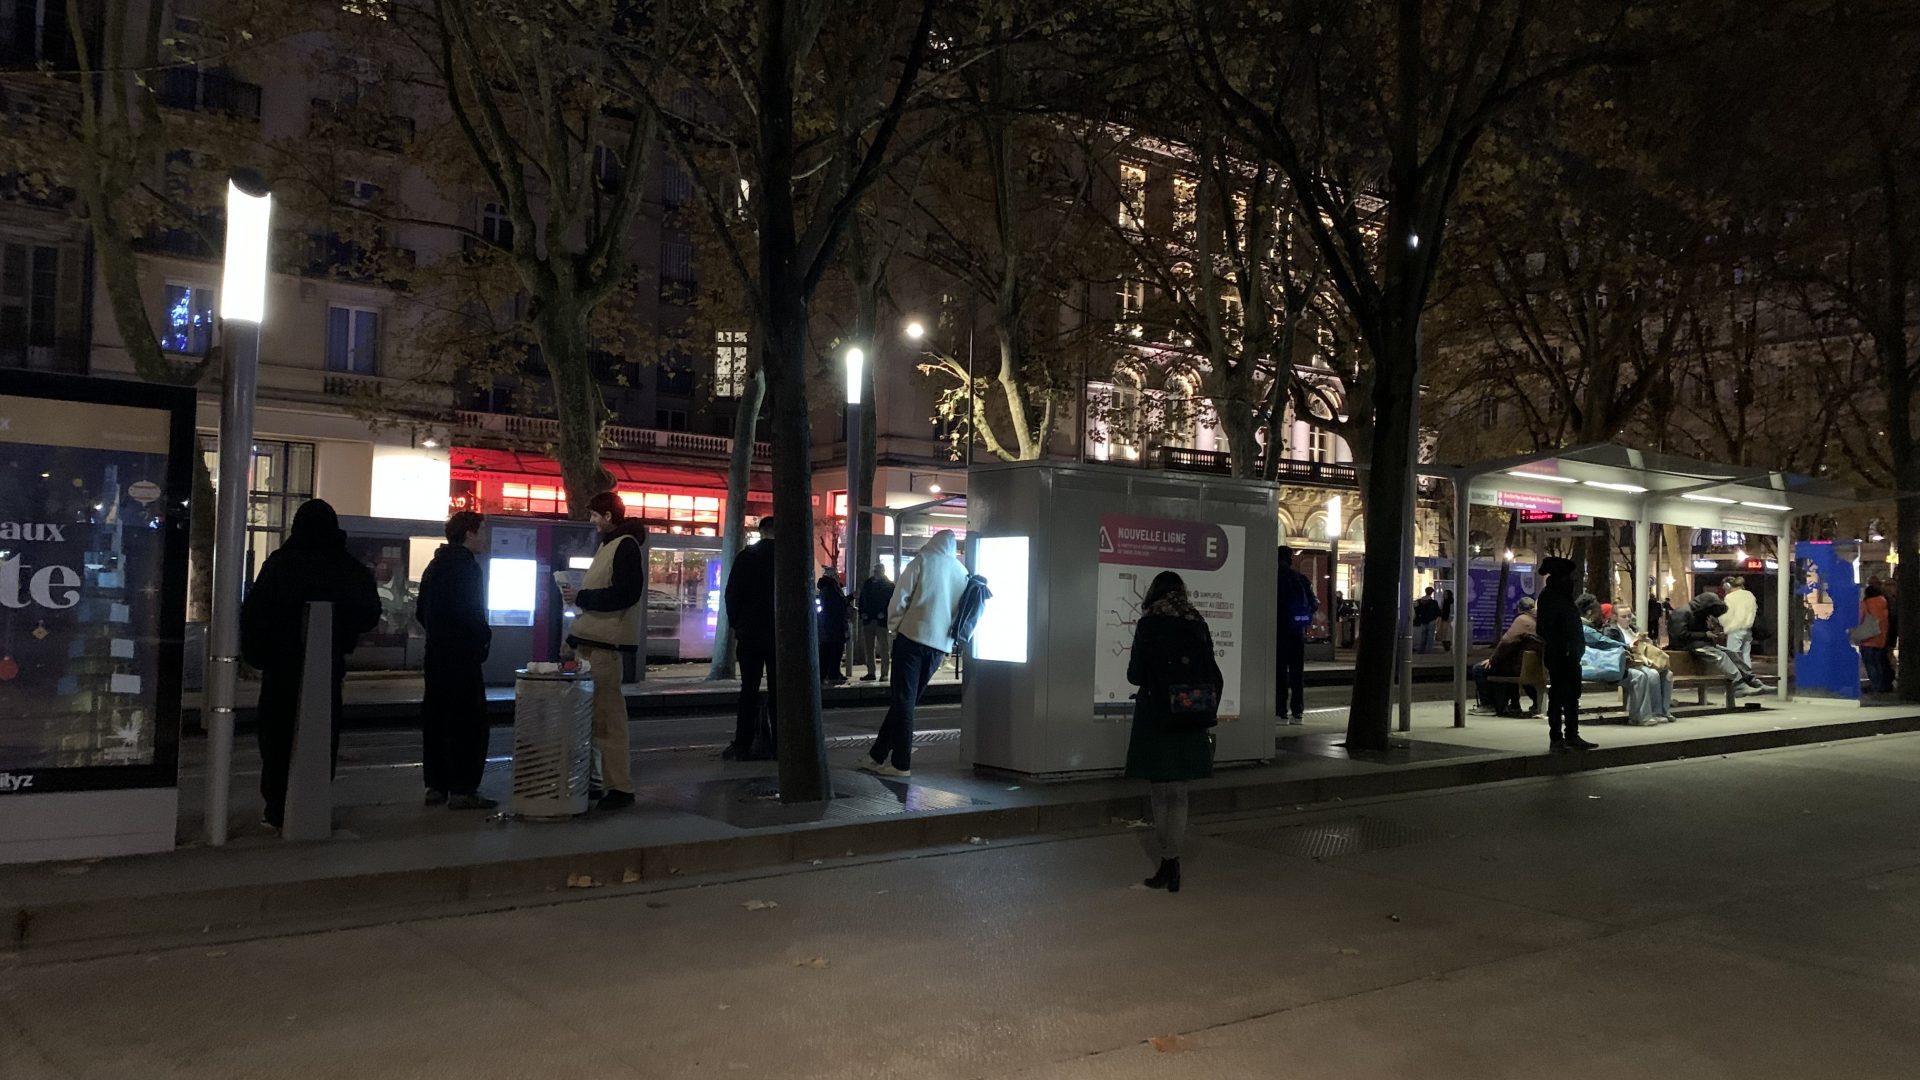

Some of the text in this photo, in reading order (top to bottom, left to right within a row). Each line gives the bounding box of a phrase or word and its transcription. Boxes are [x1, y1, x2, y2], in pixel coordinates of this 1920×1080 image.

[1118, 527, 1187, 545] NOUVELLE LIGNE
[1206, 537, 1217, 558] E
[0, 552, 81, 609] te
